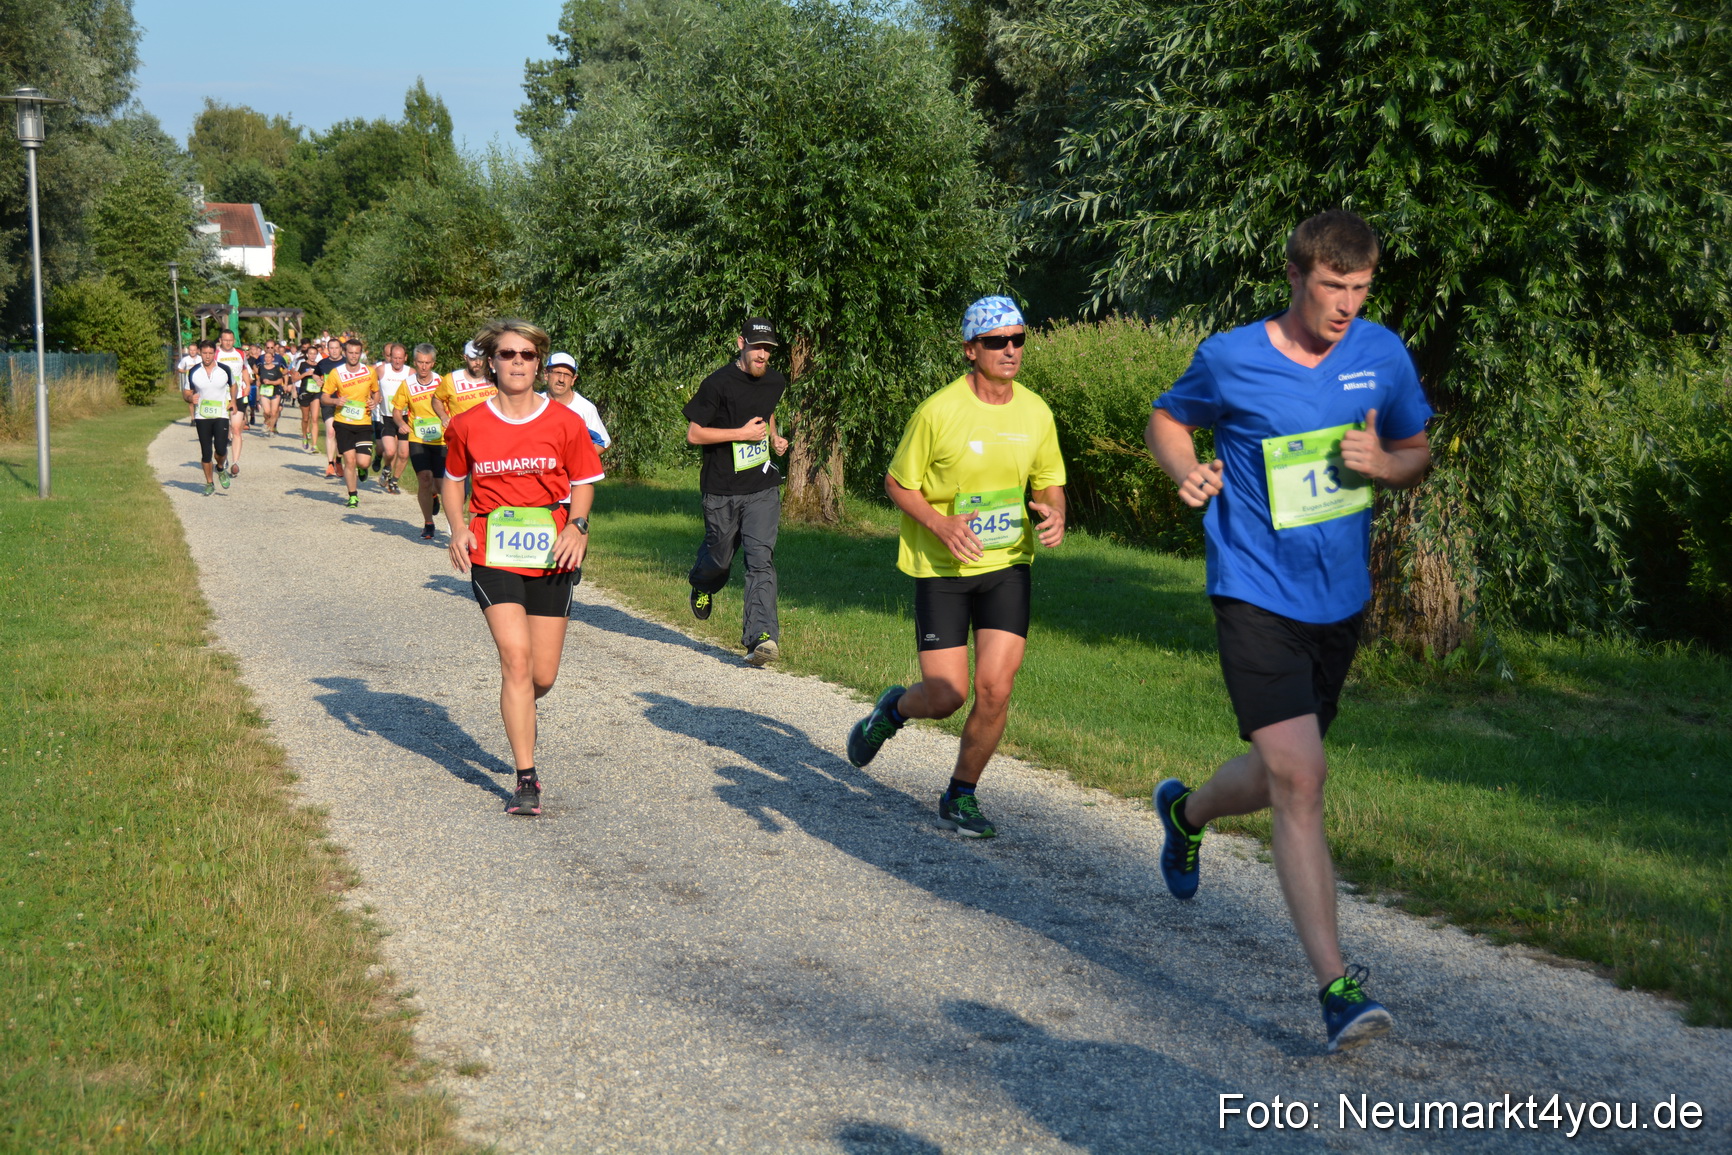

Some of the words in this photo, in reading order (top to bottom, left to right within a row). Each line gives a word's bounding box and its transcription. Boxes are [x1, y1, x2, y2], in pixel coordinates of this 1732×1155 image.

[1343, 382, 1368, 391] Allianz
[411, 395, 428, 403] MAX
[456, 393, 476, 403] MAX
[204, 406, 218, 414] 851
[345, 406, 360, 415] 864
[420, 426, 437, 435] 949
[738, 440, 768, 459] 1263
[475, 457, 547, 474] NEUMARKT
[1302, 465, 1342, 498] 13
[969, 512, 1011, 536] 645
[495, 530, 550, 551] 1408
